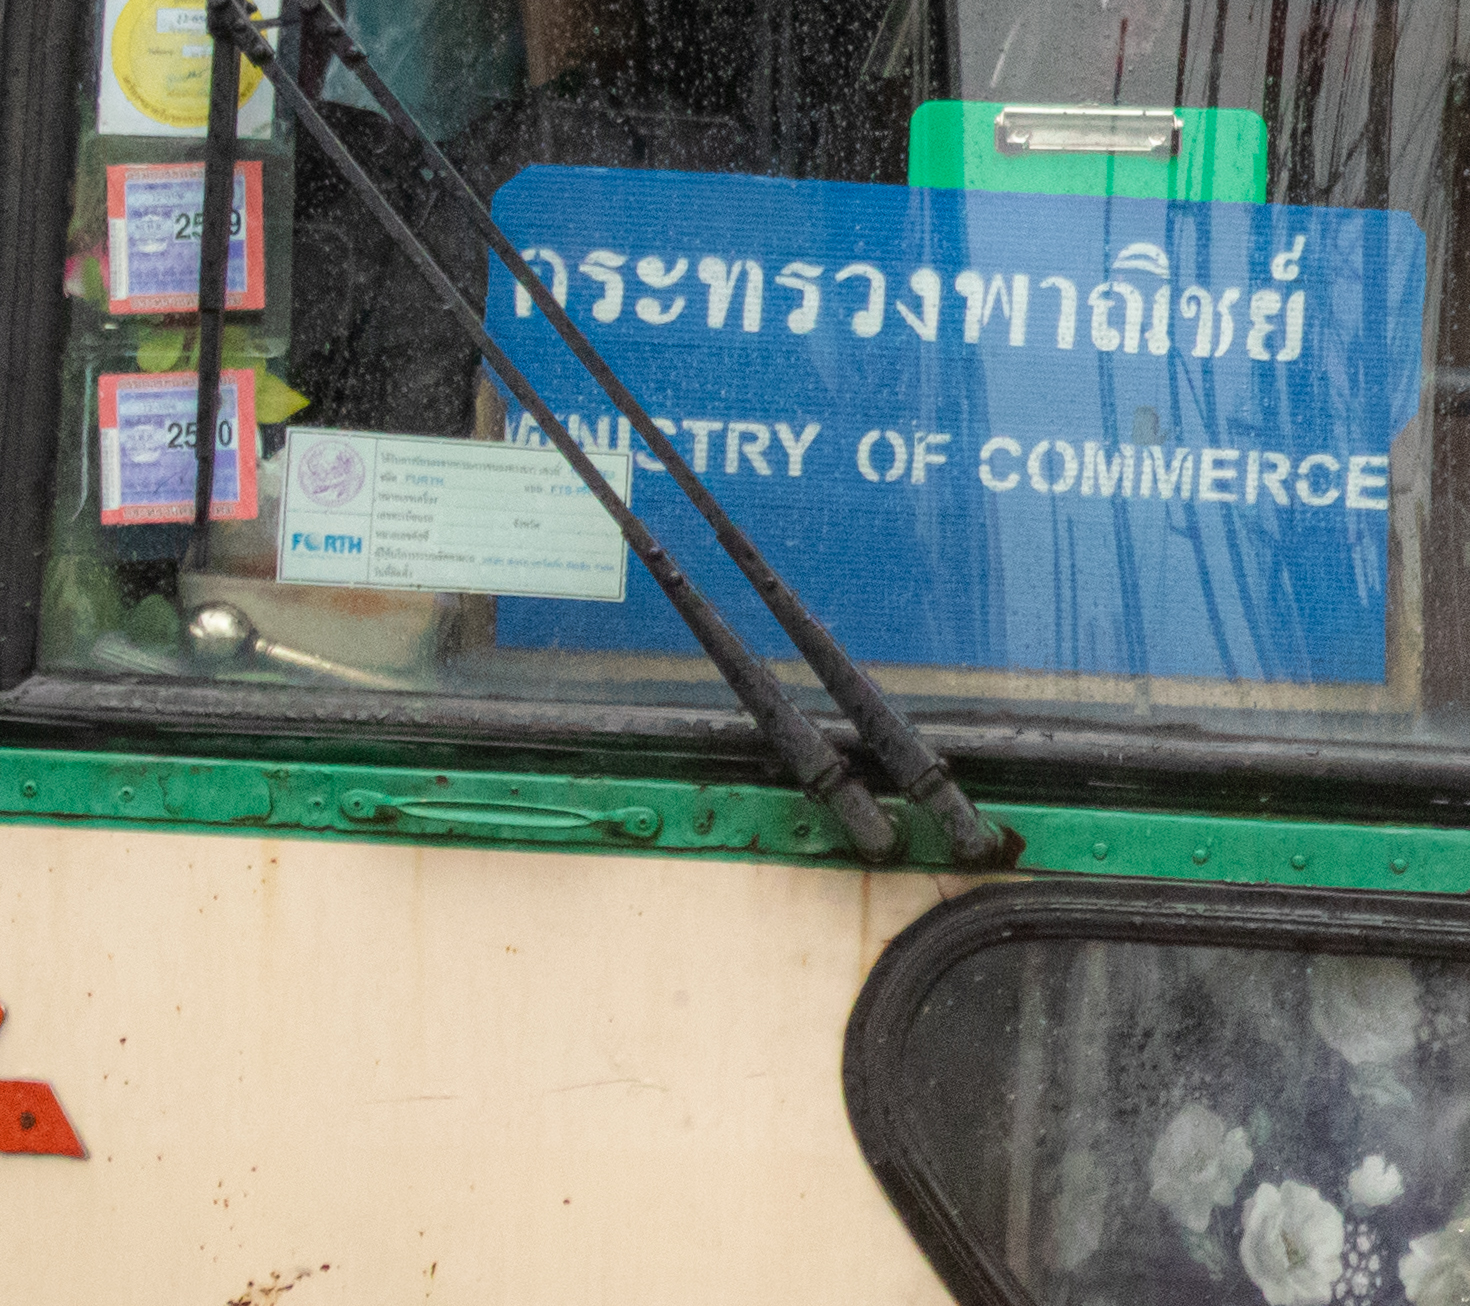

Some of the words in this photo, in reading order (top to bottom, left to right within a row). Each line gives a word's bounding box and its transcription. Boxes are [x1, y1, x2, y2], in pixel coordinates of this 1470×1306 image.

[175, 210, 242, 241] 259
[513, 234, 1307, 364] กระทรวงพาณิชย์
[167, 420, 233, 449] 250
[855, 428, 949, 487] OF
[979, 435, 1388, 512] COMMERCE
